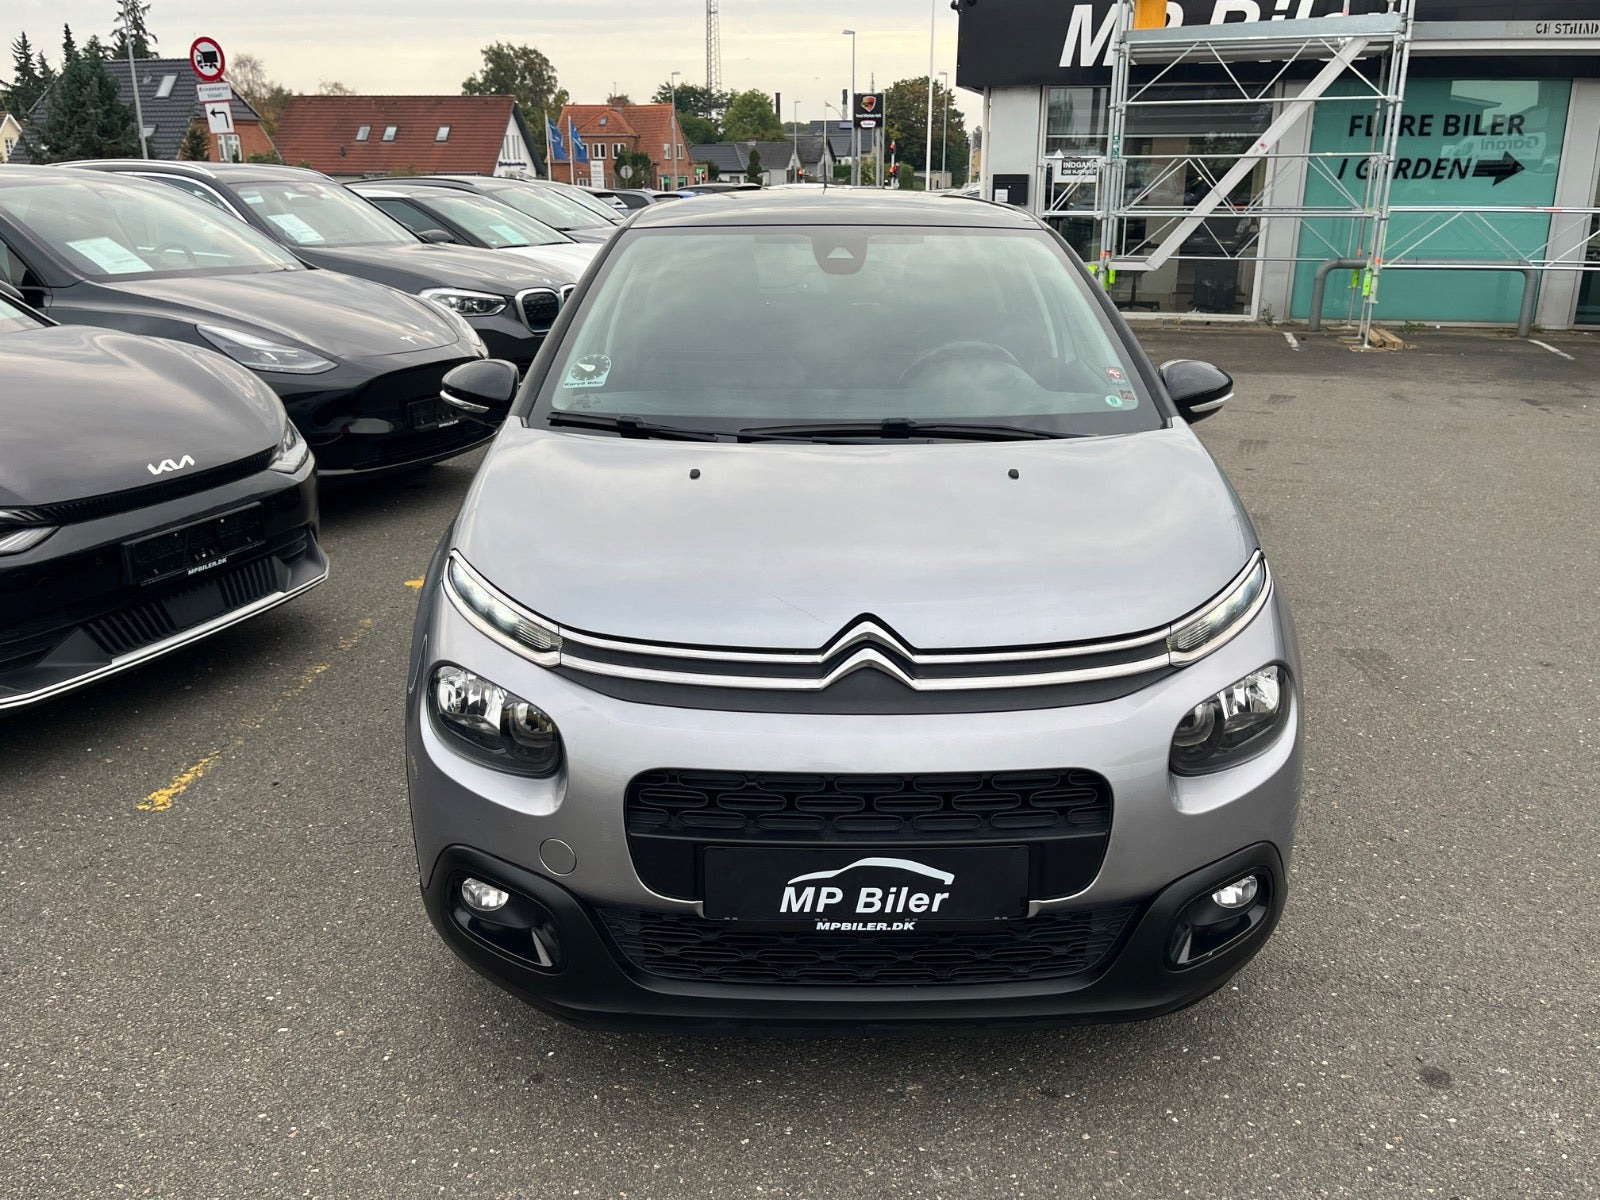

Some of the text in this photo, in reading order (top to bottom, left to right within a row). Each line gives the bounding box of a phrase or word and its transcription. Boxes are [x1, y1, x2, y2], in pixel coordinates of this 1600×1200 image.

[1442, 113, 1525, 136] BILER
[1337, 156, 1472, 179] I GRDEN
[187, 557, 227, 576] MPBILER.DK
[779, 886, 950, 914] MP Biler
[815, 921, 916, 931] MPBILER.DK
